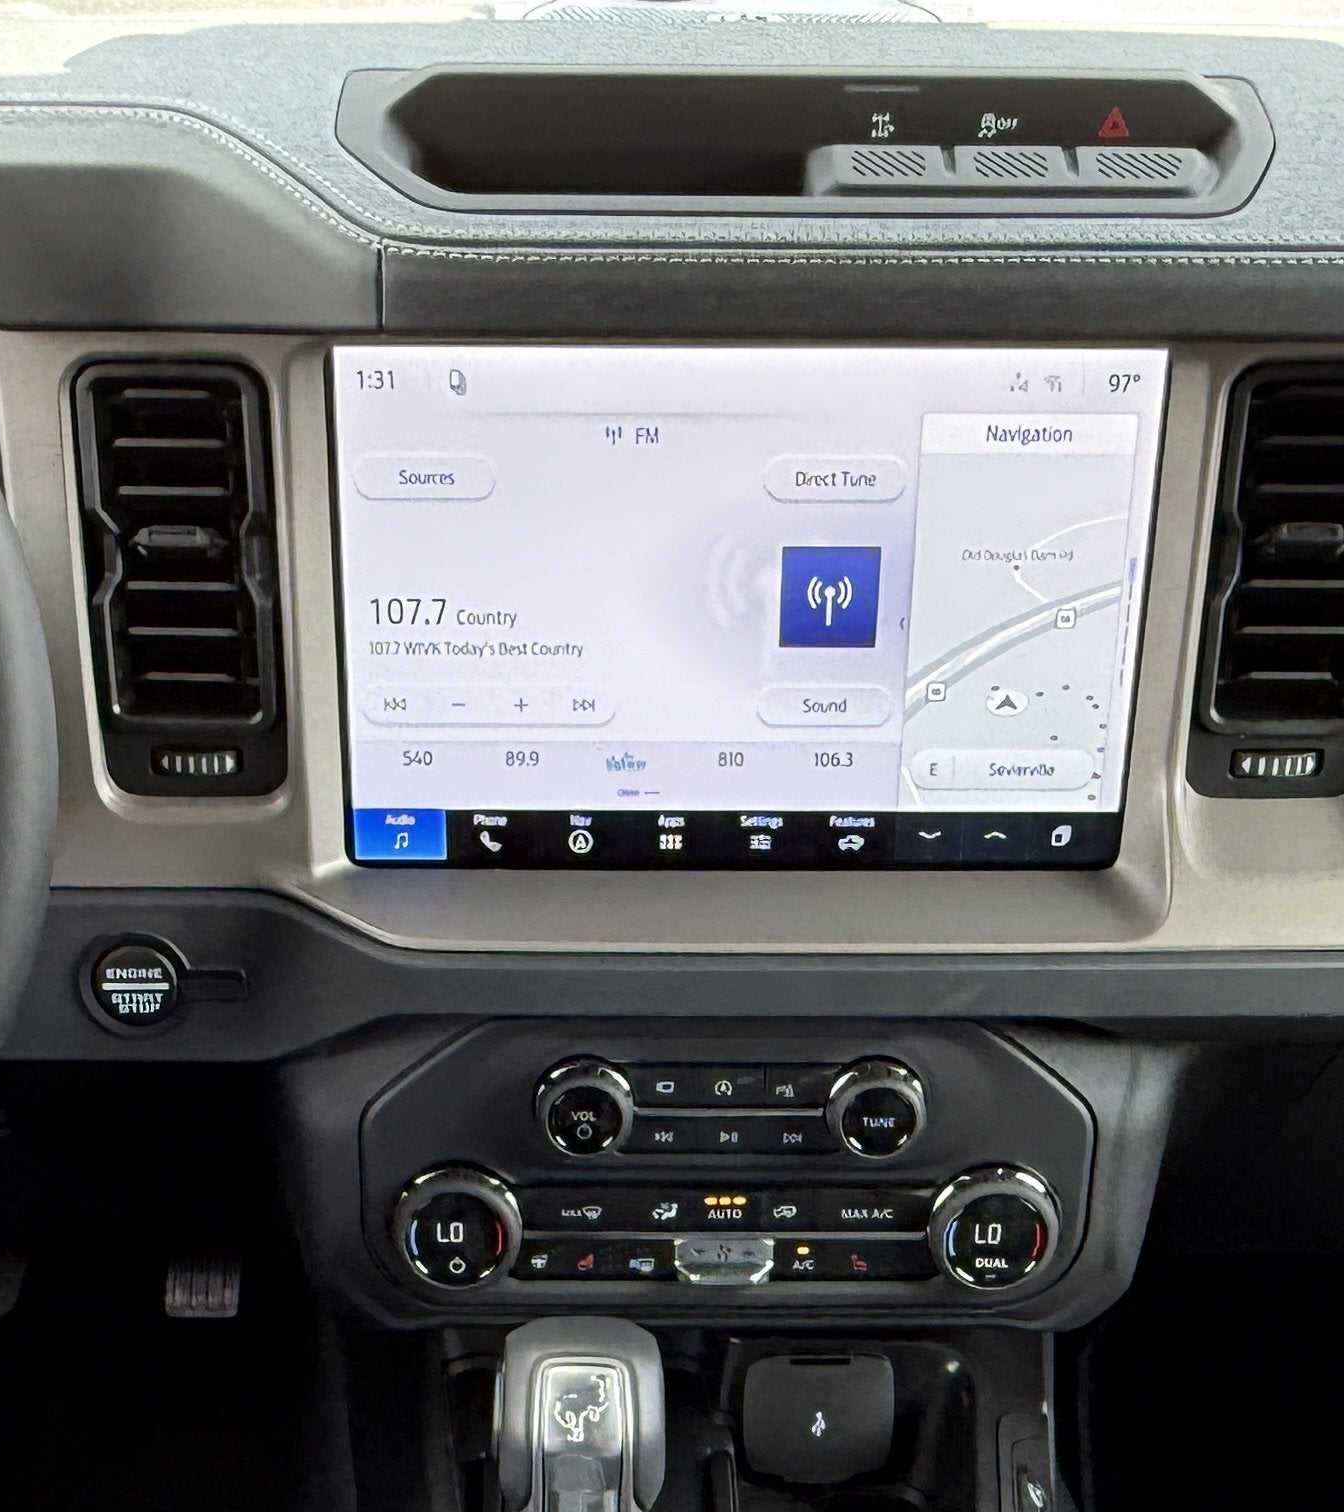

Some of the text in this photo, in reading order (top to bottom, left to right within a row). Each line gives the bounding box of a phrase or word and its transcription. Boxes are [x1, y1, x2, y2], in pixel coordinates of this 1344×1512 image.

[356, 369, 395, 389] 1:31
[1108, 373, 1141, 393] 97°
[635, 427, 659, 444] FM
[986, 425, 1073, 445] Navigation
[399, 470, 455, 485] Sources
[795, 471, 876, 487] Direct Tune
[370, 598, 517, 628] 107.7 Country
[445, 641, 496, 658] Today's
[499, 642, 527, 656] Best
[531, 642, 583, 658] Country
[803, 698, 847, 714] Sound
[402, 750, 433, 766] 540
[506, 751, 540, 766] 89.9
[718, 752, 744, 767] 810
[814, 752, 853, 767] 106.3
[929, 762, 938, 776] E
[385, 813, 416, 826] Audio
[473, 814, 507, 827] Phone
[569, 815, 593, 827] Nav
[657, 815, 686, 829] Apps
[739, 815, 784, 830] Settings
[829, 815, 876, 828] Features
[105, 967, 163, 979] ENGINE
[571, 1111, 598, 1122] VOL
[863, 1116, 896, 1129] TUNE
[707, 1208, 743, 1220] AUTO
[841, 1208, 894, 1220] MAX A/C
[436, 1222, 464, 1244] LO
[974, 1223, 1002, 1246] LO
[975, 1257, 1009, 1269] DUAL
